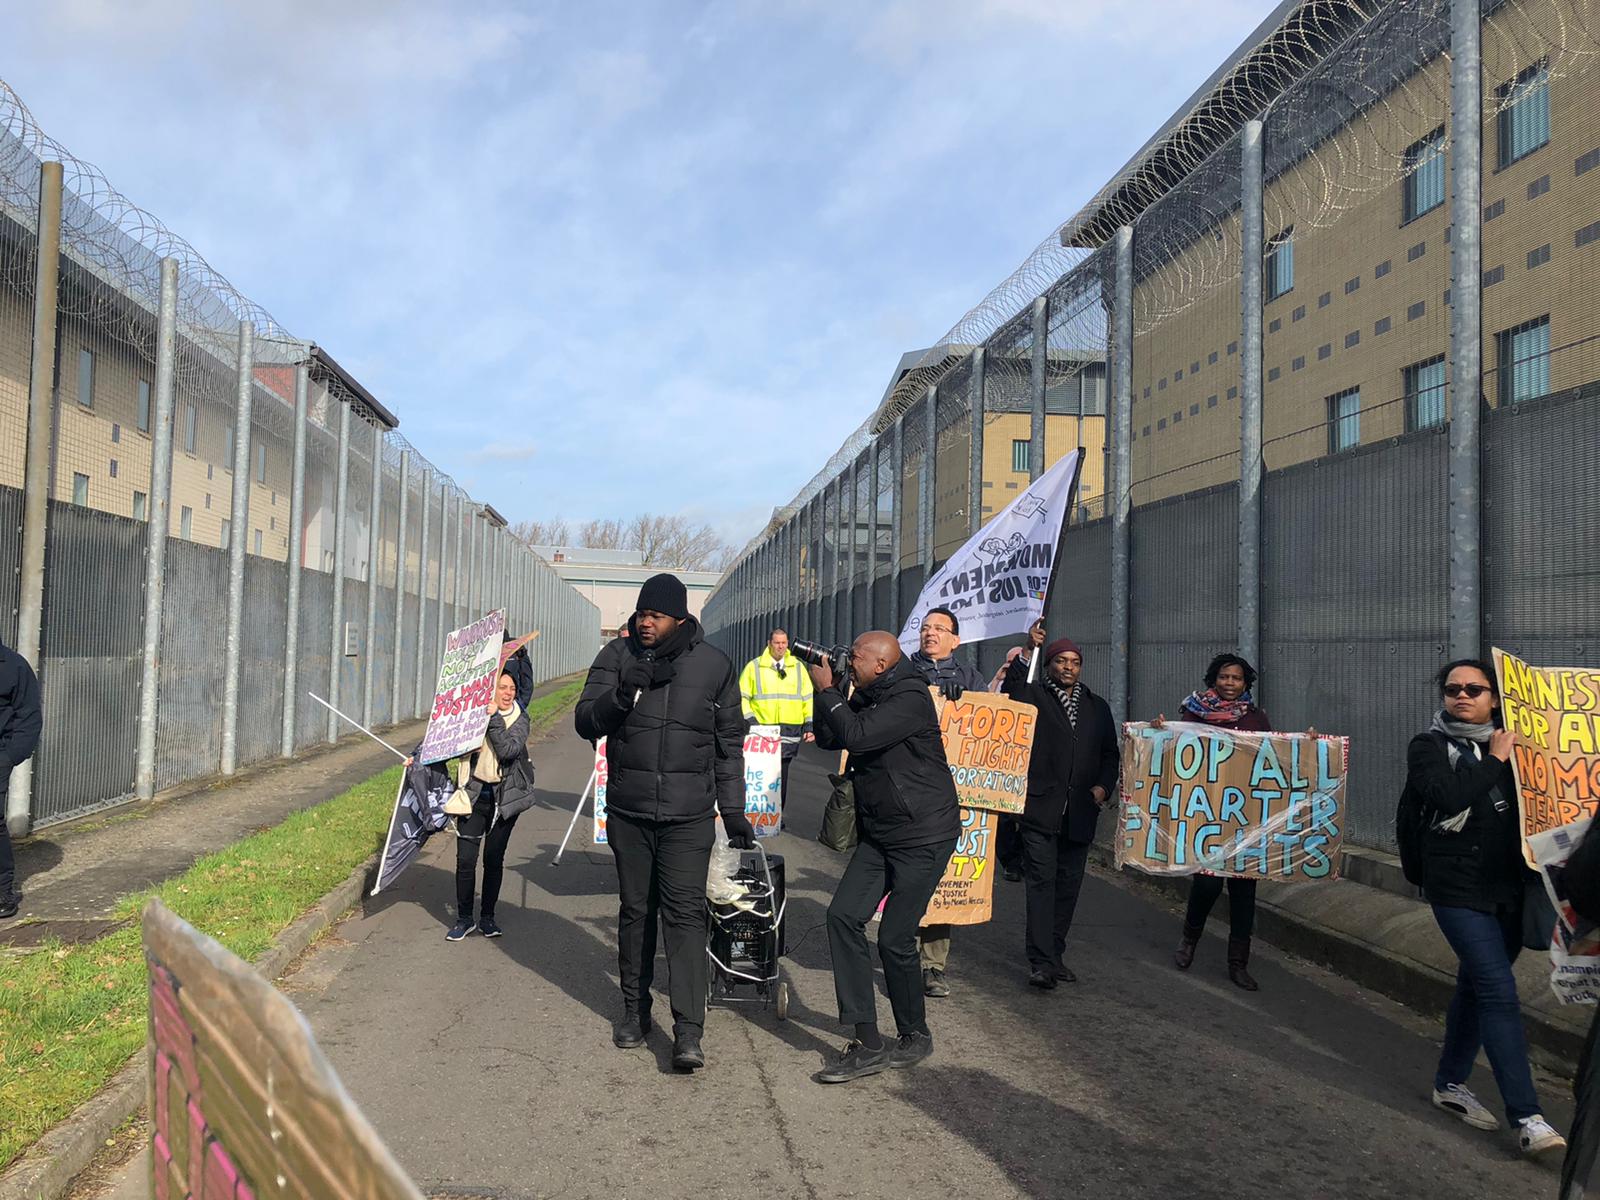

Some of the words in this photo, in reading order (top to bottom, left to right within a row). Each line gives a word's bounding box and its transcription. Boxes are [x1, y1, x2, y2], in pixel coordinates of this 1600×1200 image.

[437, 657, 497, 693] ACCEPTED
[441, 655, 476, 678] NOT
[461, 668, 498, 696] WANT
[431, 686, 494, 720] JUSTICE
[940, 699, 1034, 747] MORE
[1503, 696, 1550, 750] FOR
[958, 737, 1030, 773] FLIGHTS
[1135, 727, 1236, 783] TOP
[1250, 737, 1338, 791] ALL
[1514, 744, 1549, 793] NO
[768, 777, 781, 793] of
[950, 764, 1027, 797] PORTATIONS
[744, 812, 780, 828] TAY
[745, 801, 775, 813] TAIN
[1136, 781, 1341, 838] HARTER
[955, 828, 991, 858] UST
[938, 880, 973, 889] OVEMENT
[951, 855, 988, 881] TY
